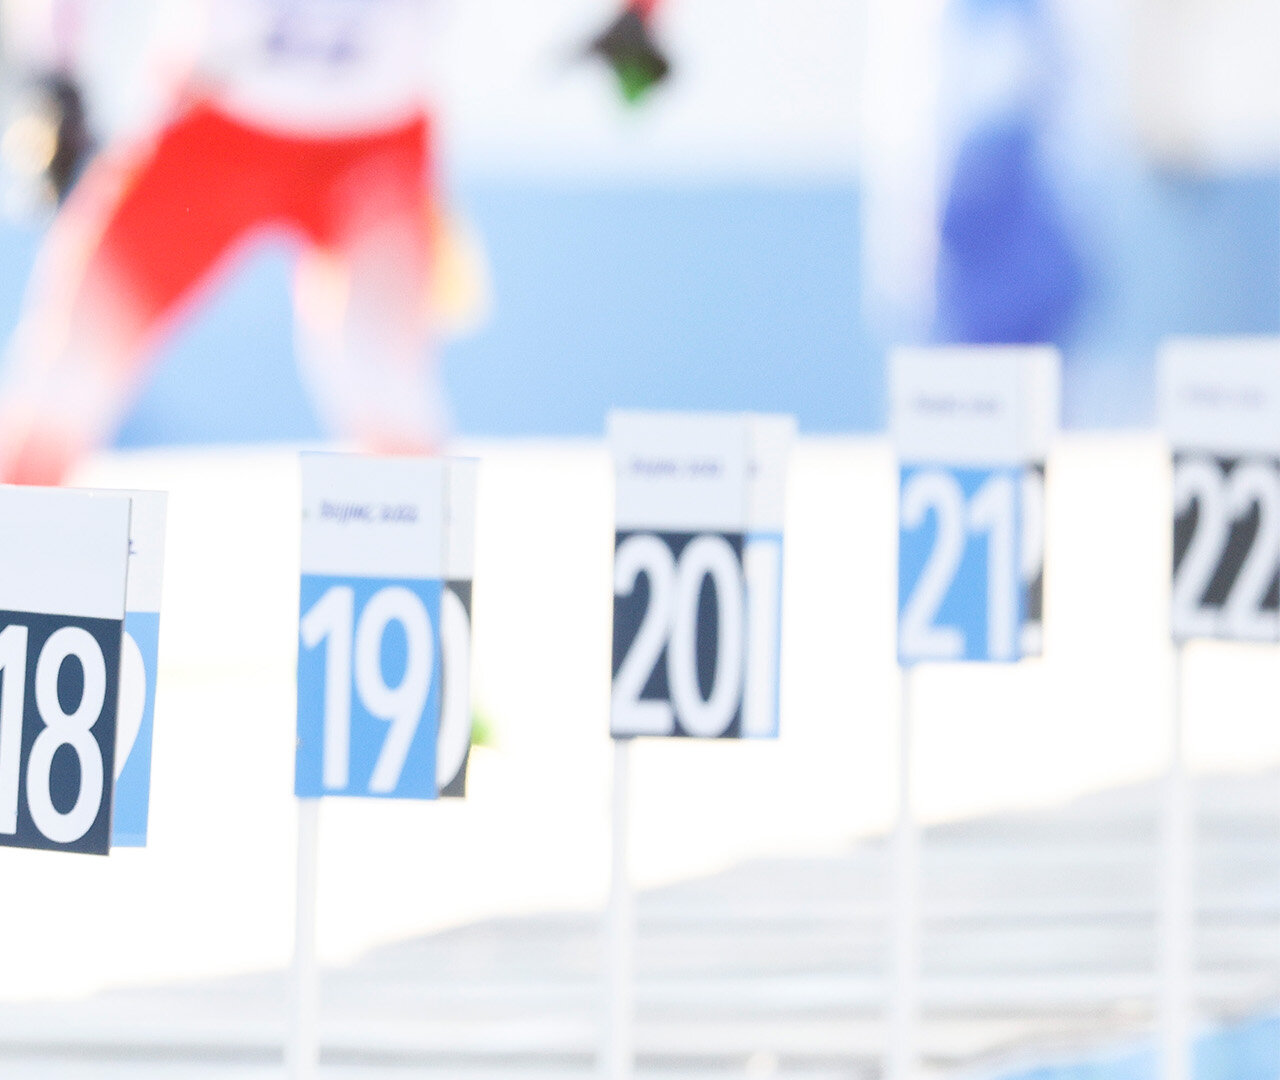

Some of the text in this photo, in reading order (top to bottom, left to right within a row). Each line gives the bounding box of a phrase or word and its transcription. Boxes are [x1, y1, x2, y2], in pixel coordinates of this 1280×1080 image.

[611, 533, 742, 737] 20
[899, 471, 1016, 658] 21
[1172, 462, 1280, 639] 22
[300, 585, 435, 794] 19
